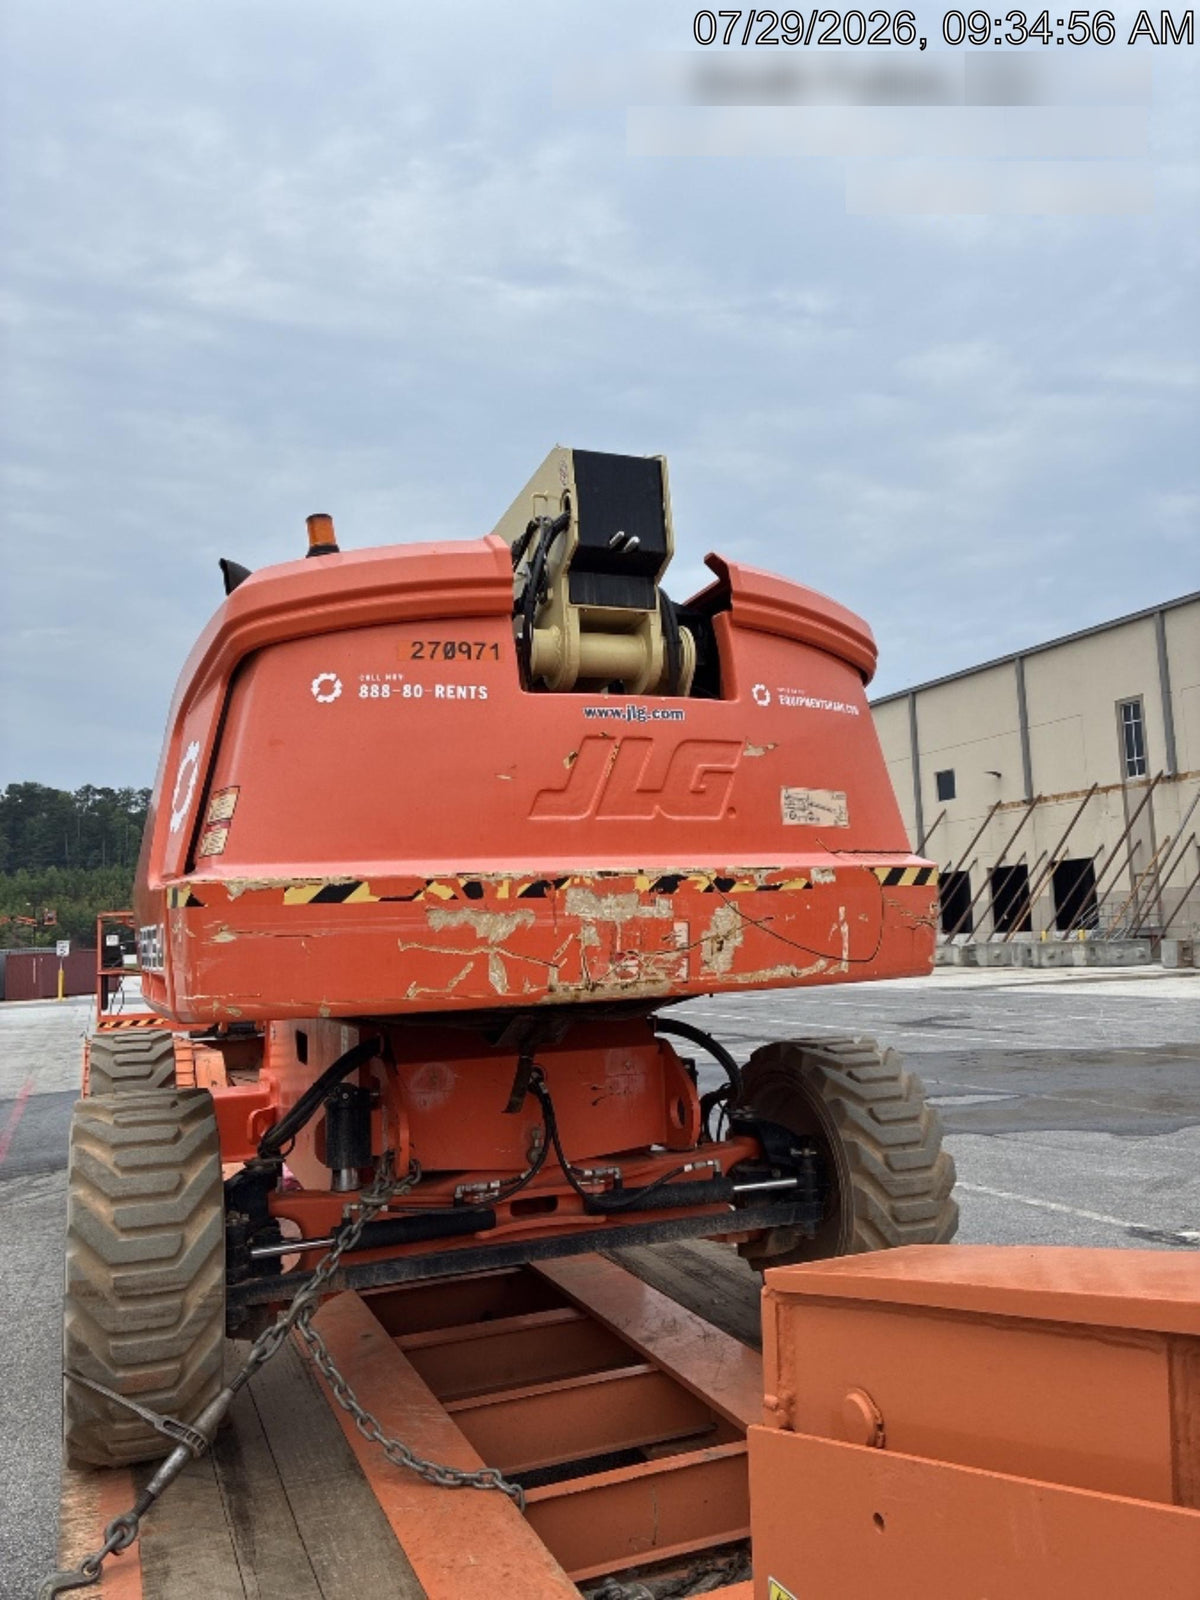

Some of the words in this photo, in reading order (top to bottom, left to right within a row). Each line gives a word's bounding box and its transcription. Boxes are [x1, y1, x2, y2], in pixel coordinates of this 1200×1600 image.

[410, 640, 500, 661] 270971
[583, 704, 685, 722] www.jlg.com
[528, 735, 744, 822] JLG
